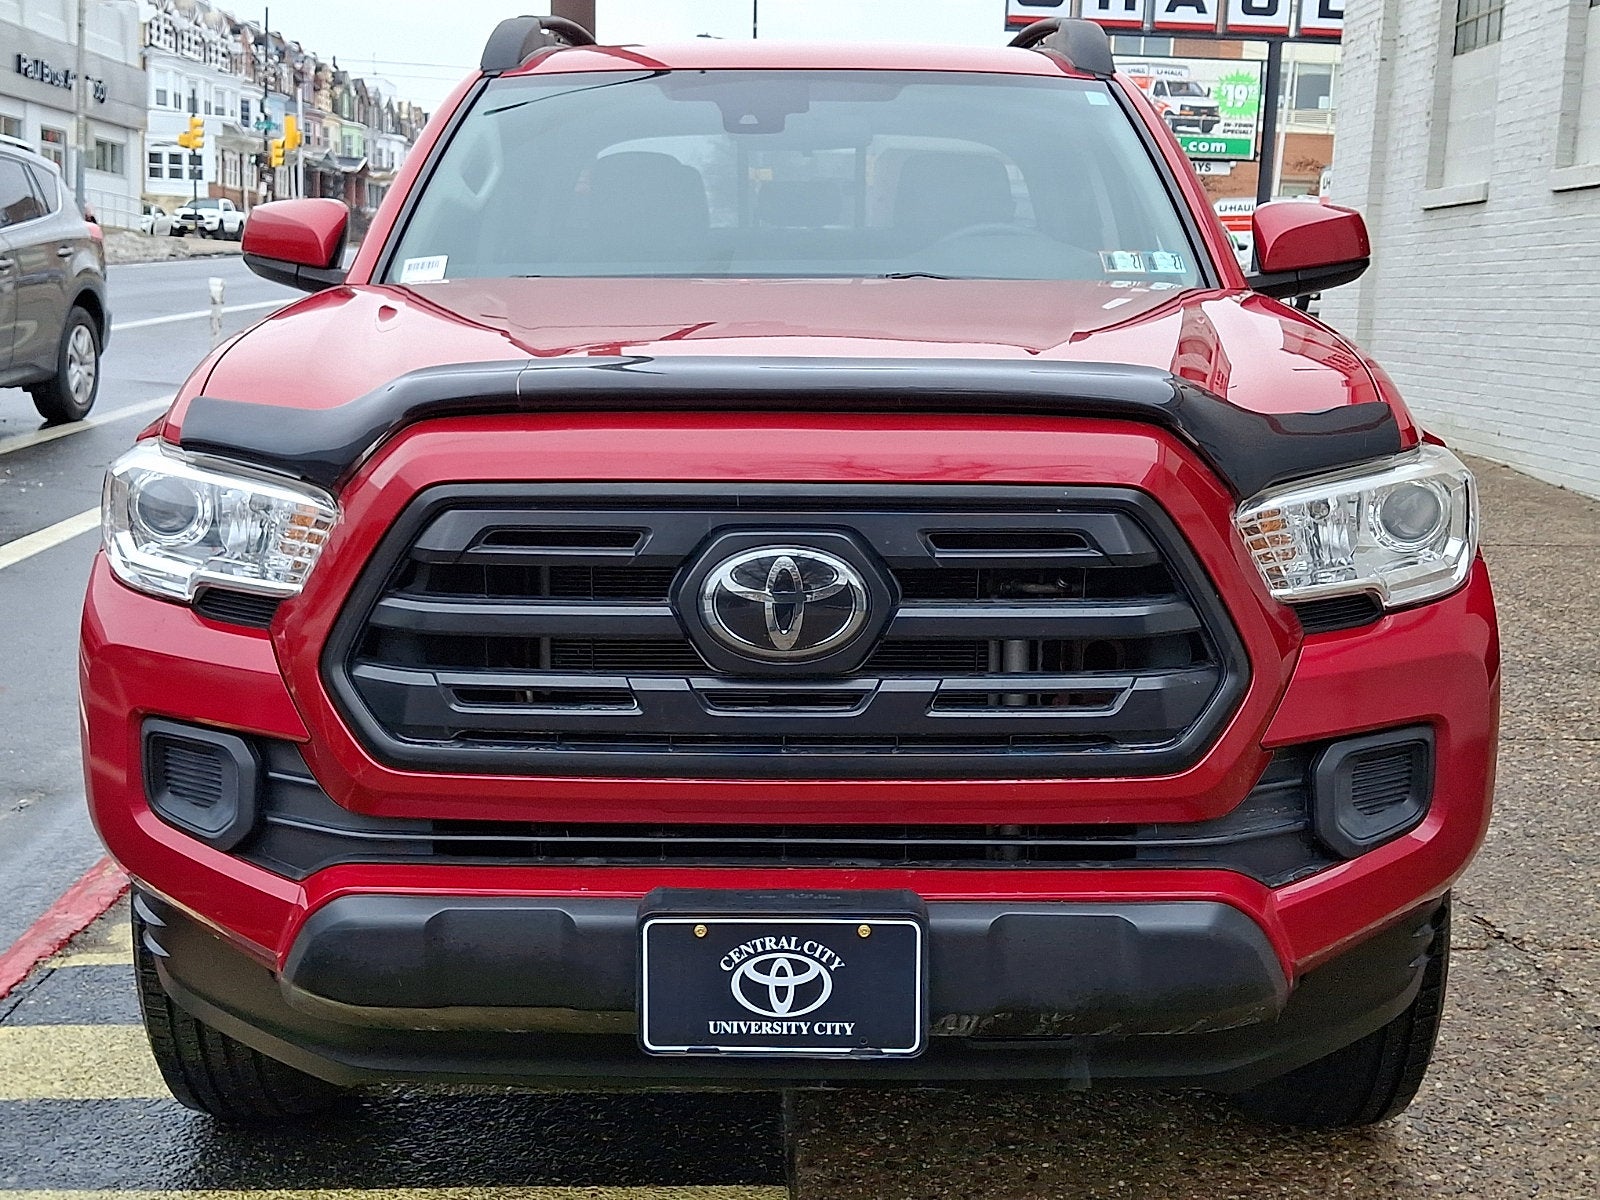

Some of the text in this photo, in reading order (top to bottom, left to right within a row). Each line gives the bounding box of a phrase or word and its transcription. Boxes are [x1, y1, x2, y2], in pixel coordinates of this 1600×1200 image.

[1180, 139, 1227, 153] .com
[720, 936, 846, 972] CENTRAL CITY
[708, 1020, 855, 1036] UNIVERSITY CITY
